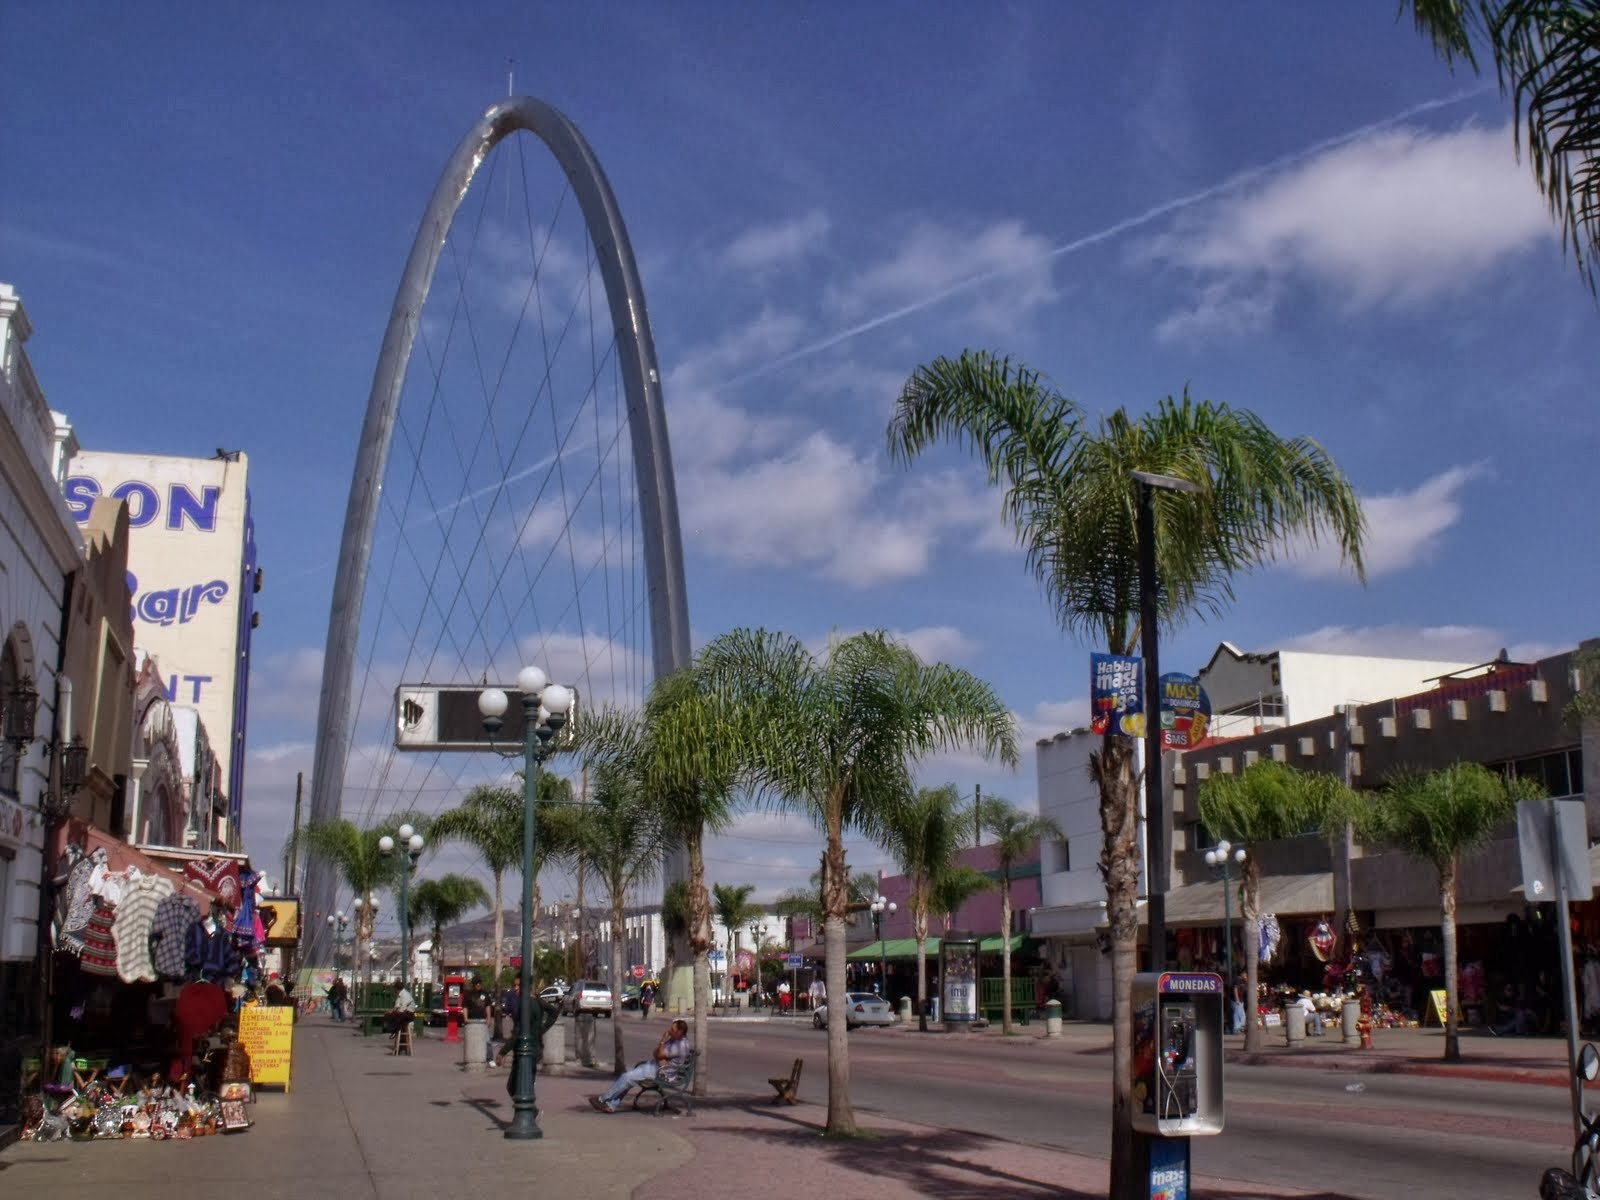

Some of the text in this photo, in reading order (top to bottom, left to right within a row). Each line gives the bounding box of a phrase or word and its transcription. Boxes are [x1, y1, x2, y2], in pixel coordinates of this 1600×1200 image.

[1097, 660, 1132, 674] Habla
[1120, 686, 1136, 694] con
[1098, 692, 1138, 712] migo
[1169, 698, 1200, 709] DOMINGOS
[1165, 733, 1187, 745] SMS
[1170, 979, 1216, 991] MONEDAS
